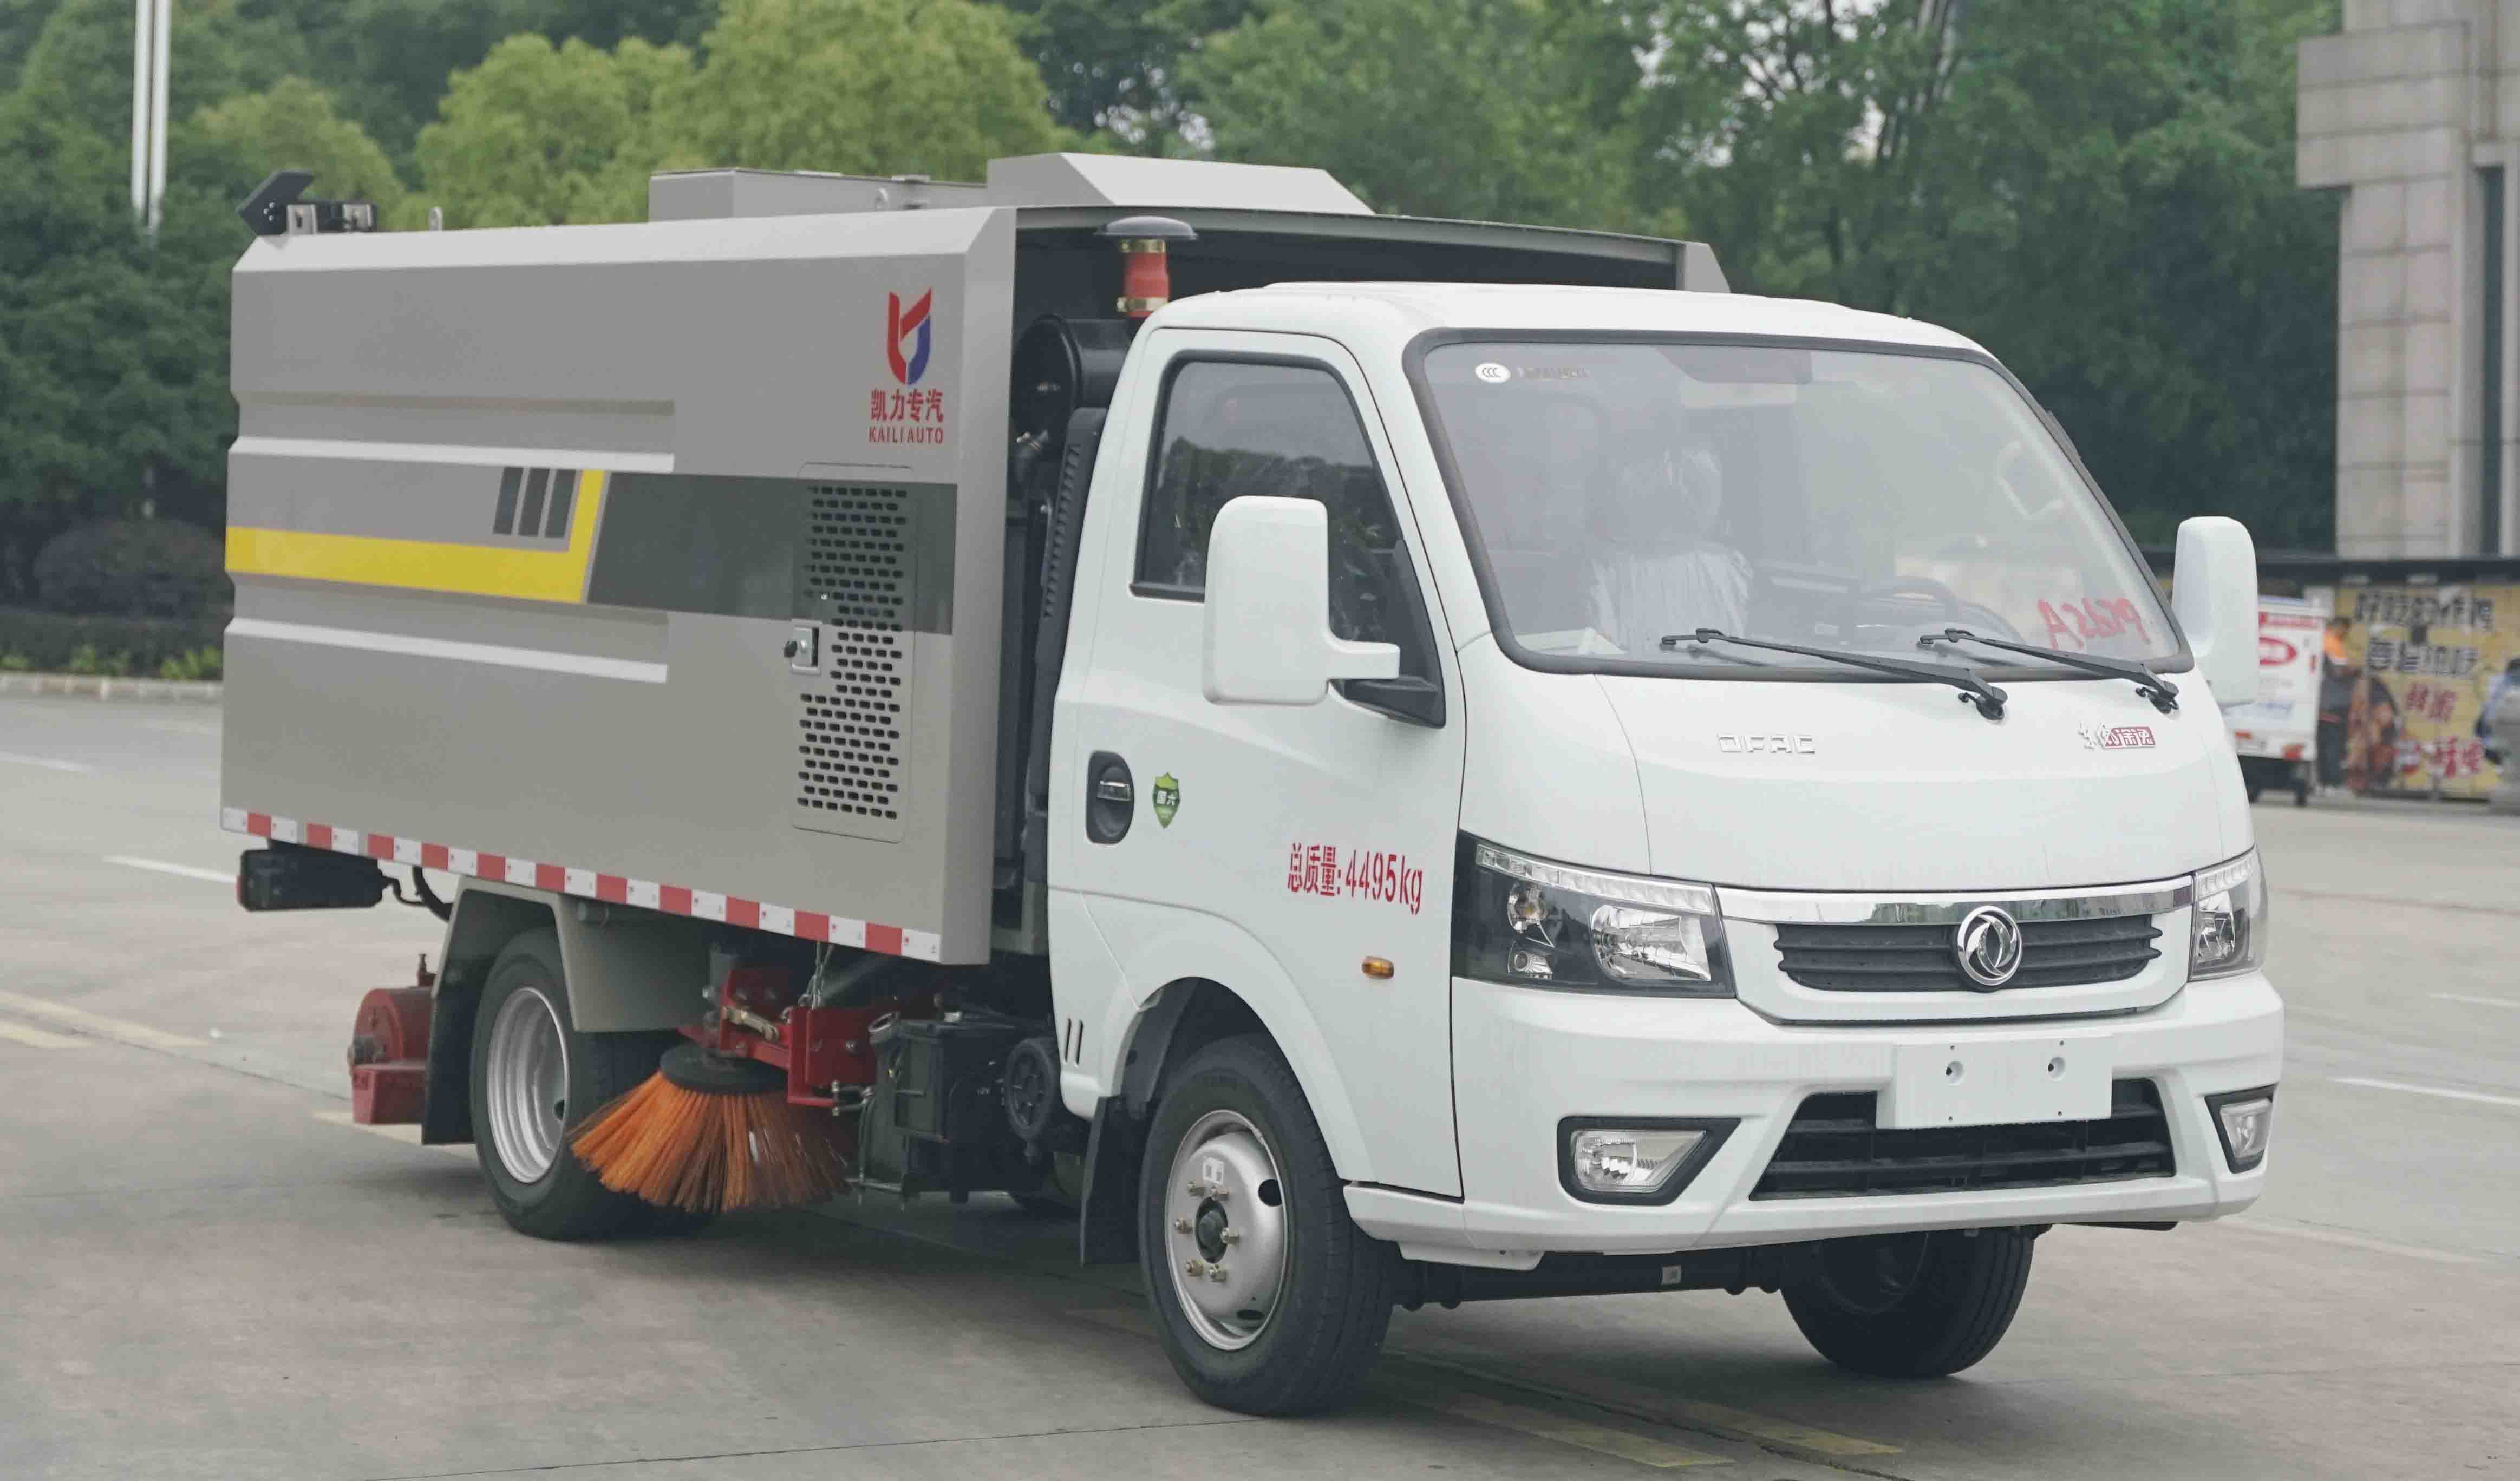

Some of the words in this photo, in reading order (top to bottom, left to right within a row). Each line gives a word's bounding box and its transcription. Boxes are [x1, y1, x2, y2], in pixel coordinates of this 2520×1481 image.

[870, 388, 944, 423] 凯力专汽
[869, 426, 903, 443] KAILI
[906, 426, 944, 443] AUTO
[1716, 733, 1816, 753] DFAC
[1288, 842, 1423, 916] 总质量:4495kg
